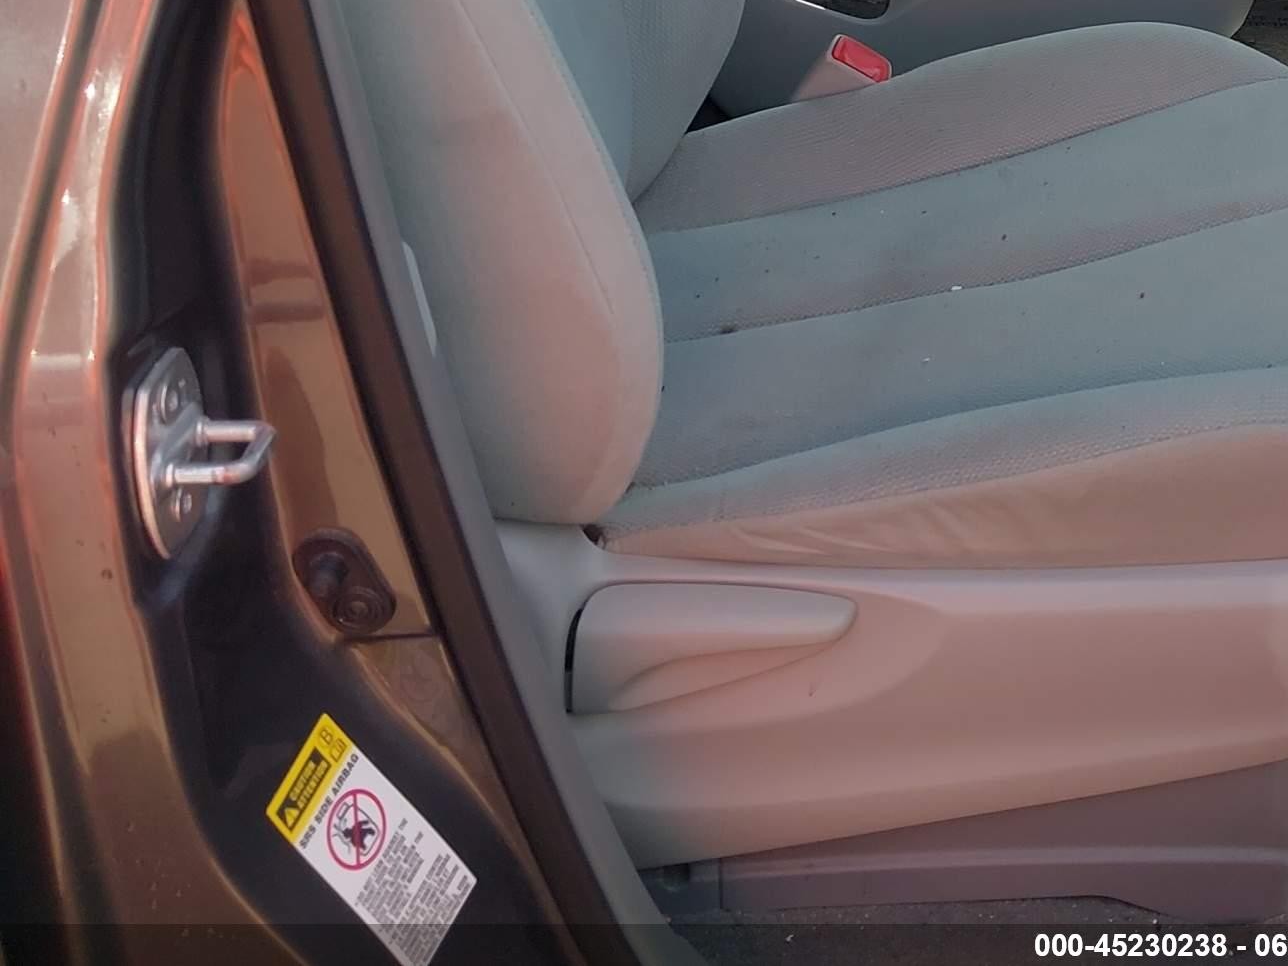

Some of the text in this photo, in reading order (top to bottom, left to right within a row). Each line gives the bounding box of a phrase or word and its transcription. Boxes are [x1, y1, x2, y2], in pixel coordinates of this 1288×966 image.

[299, 753, 360, 850] SRS SIDE AIRBAG
